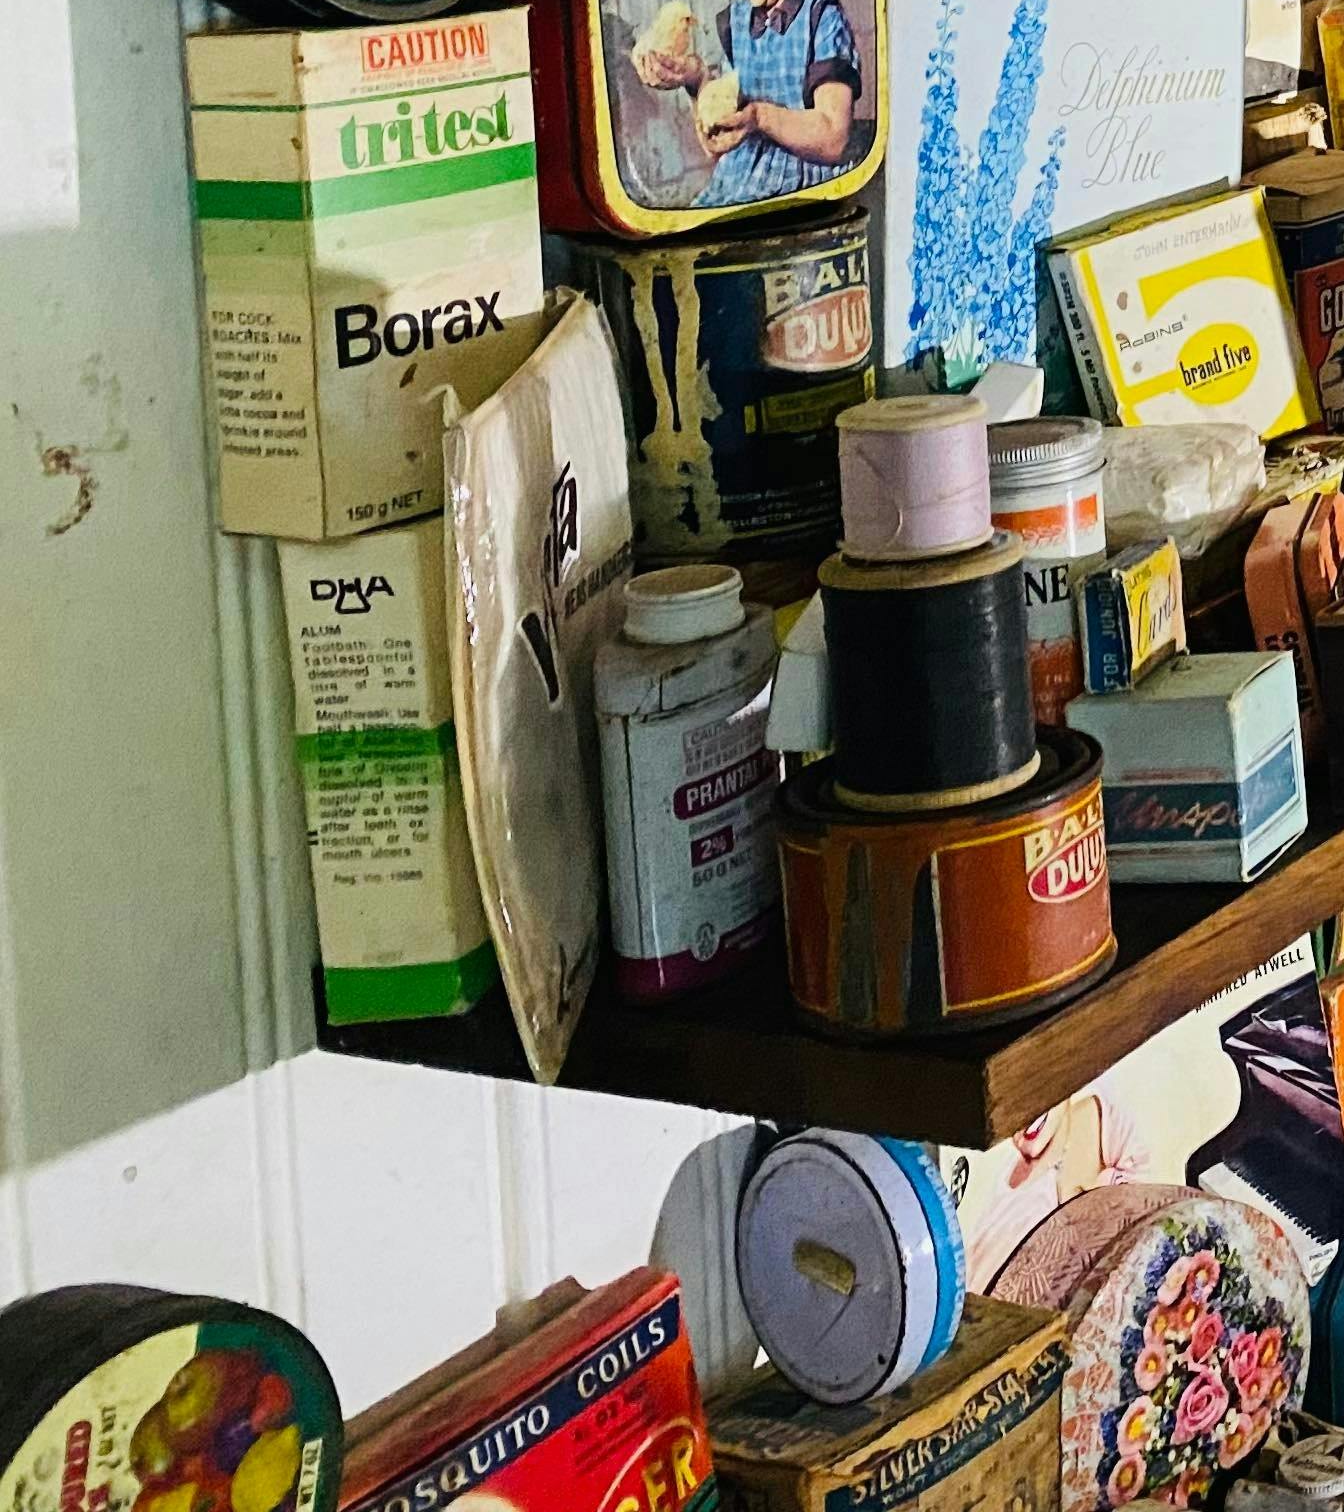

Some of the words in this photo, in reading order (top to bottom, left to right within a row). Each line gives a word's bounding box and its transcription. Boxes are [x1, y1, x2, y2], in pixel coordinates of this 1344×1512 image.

[367, 23, 486, 70] CAUTION
[1058, 42, 1226, 117] Delphinium
[1081, 115, 1167, 188] Blue
[334, 289, 505, 369] Borax
[1179, 347, 1222, 387] brand
[1223, 343, 1252, 375] five
[391, 489, 424, 509] NET
[1103, 652, 1119, 688] FOR
[576, 1315, 666, 1400] COILS
[852, 1437, 934, 1505] SILVER
